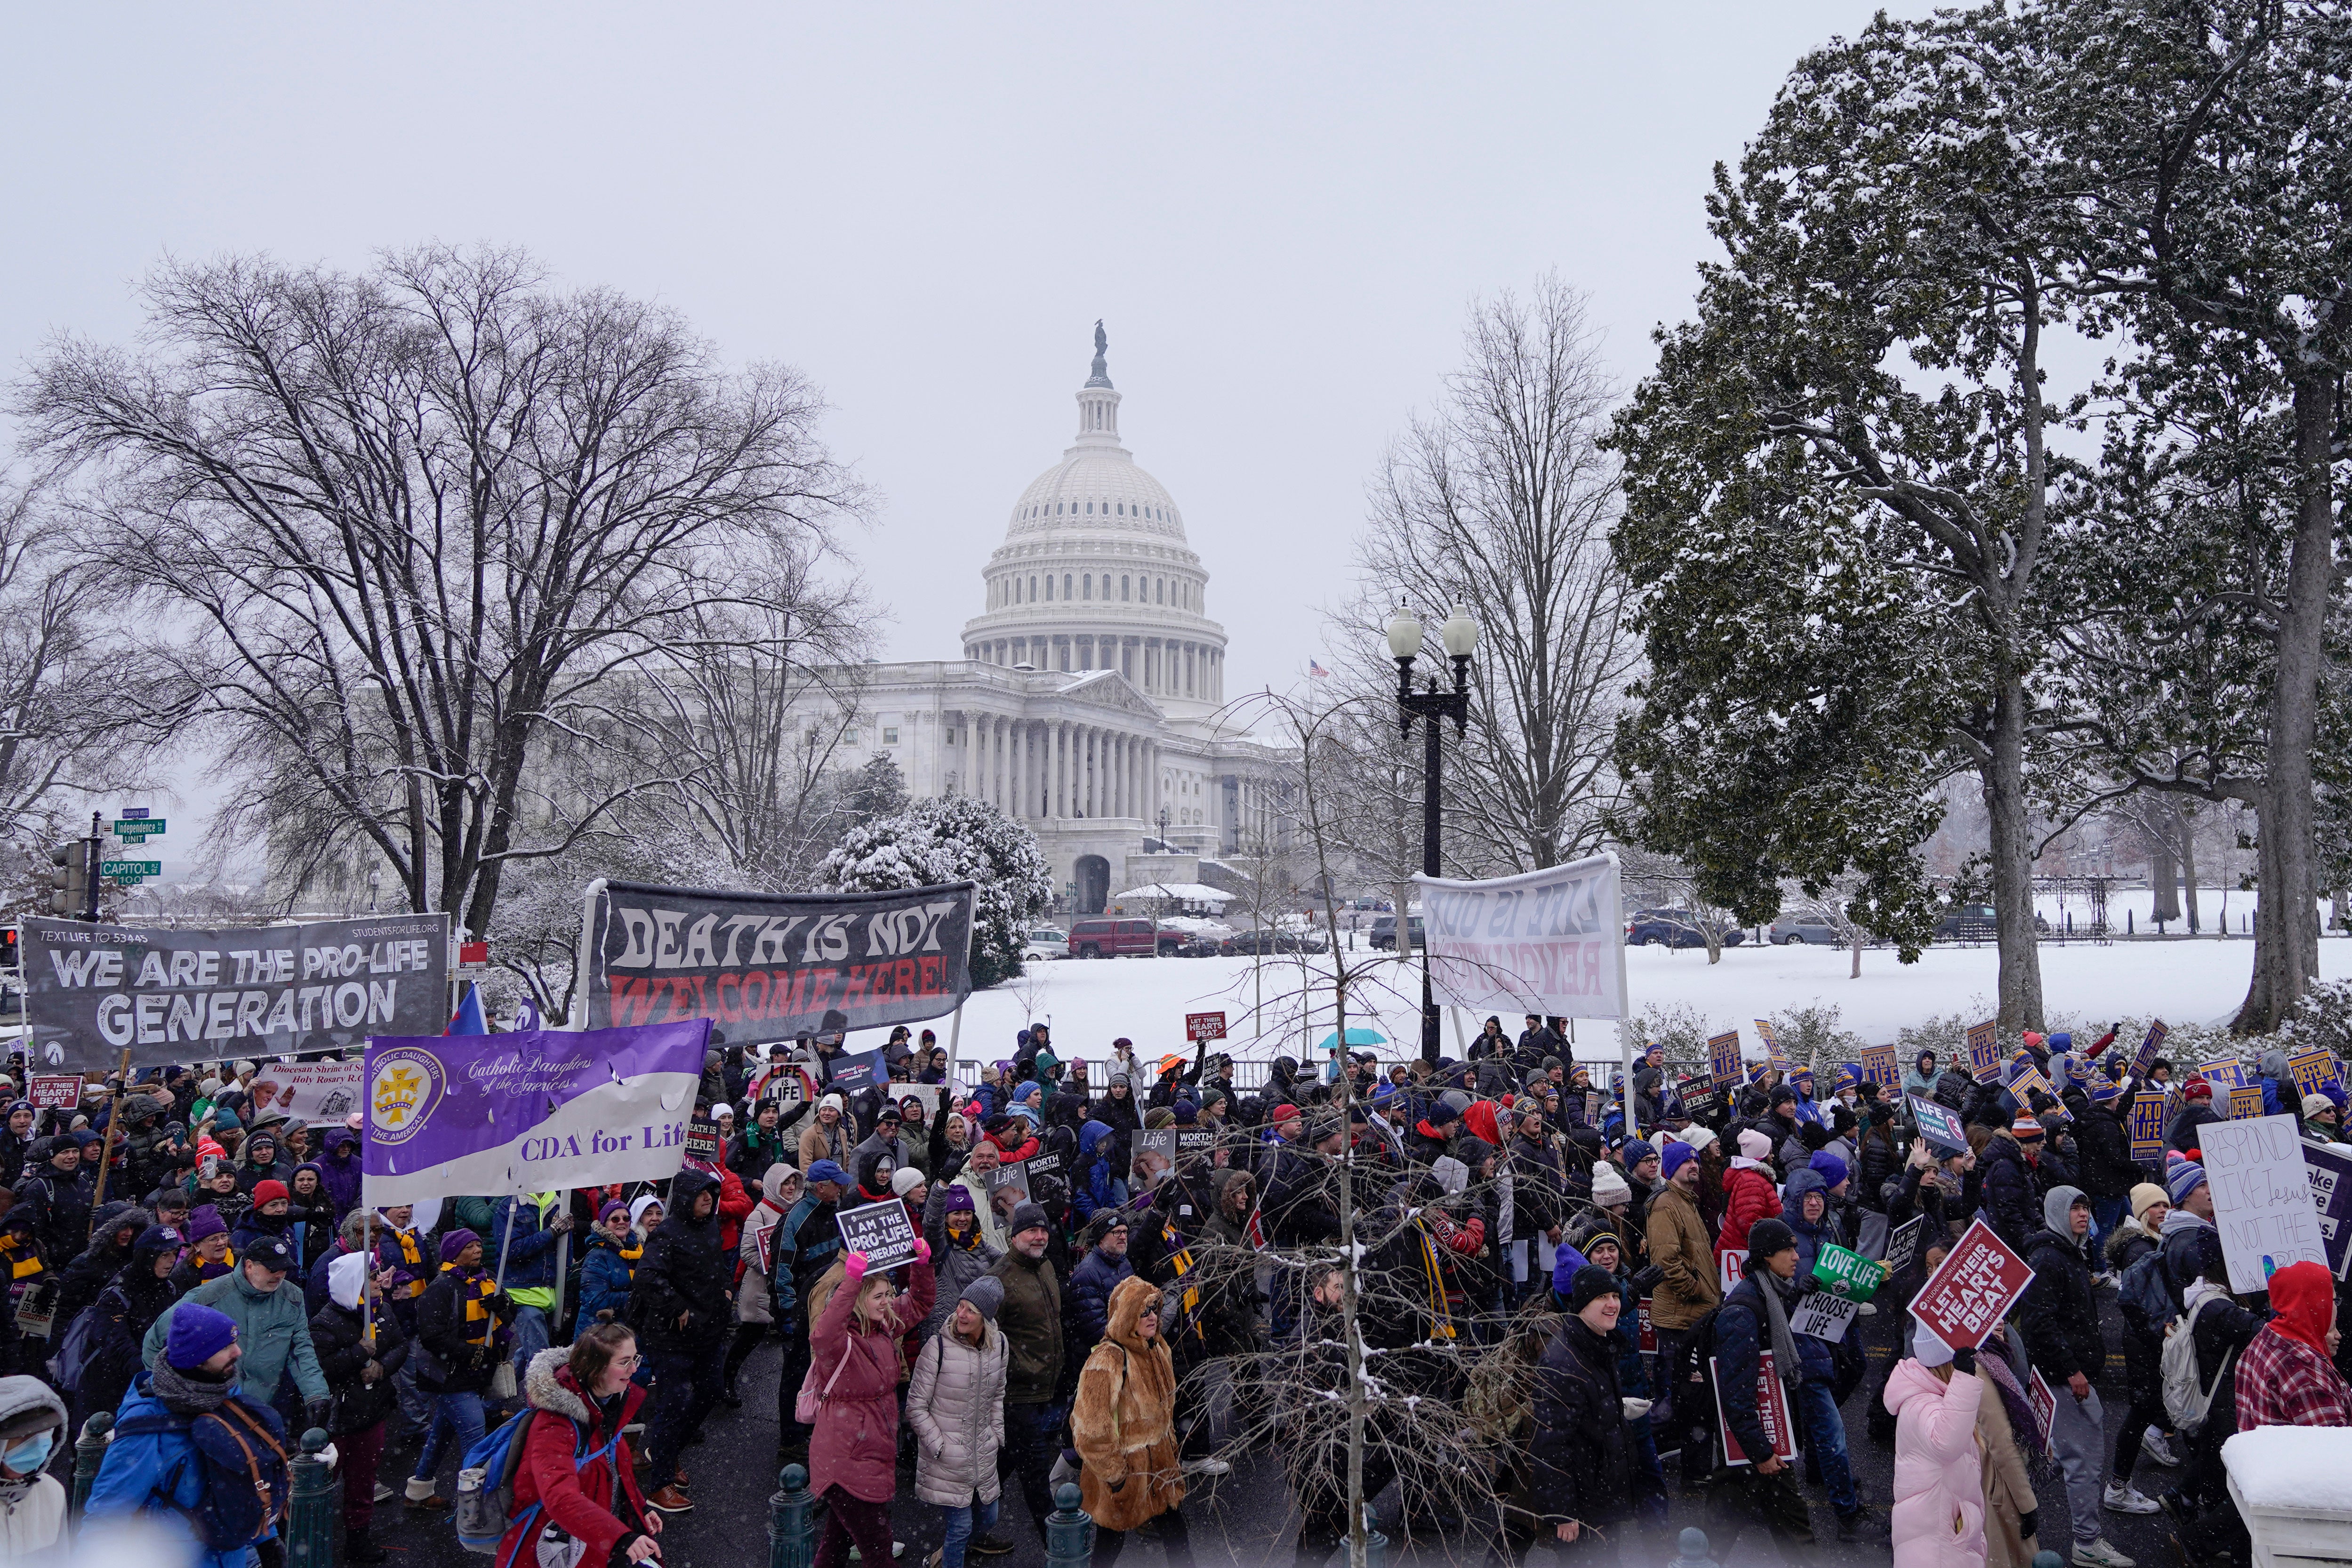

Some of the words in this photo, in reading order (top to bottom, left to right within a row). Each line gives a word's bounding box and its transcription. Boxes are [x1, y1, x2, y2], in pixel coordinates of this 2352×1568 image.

[118, 821, 156, 836] Independence
[125, 835, 143, 843] UNIT
[103, 863, 149, 875] CAPITOL
[40, 931, 66, 942] TEXT
[70, 932, 91, 942] LIFE
[94, 933, 110, 943] TO
[113, 933, 148, 943] 53445
[352, 924, 439, 938] STUDENTSFORLIFE.ORG
[610, 907, 808, 969] DEATH
[801, 913, 860, 963] IS
[866, 901, 957, 957] NOT
[49, 949, 123, 988] WE
[133, 951, 221, 987] ARE
[228, 949, 295, 984] THE
[303, 939, 428, 980] PRO-LIFE
[608, 967, 838, 1028] WELCOME
[837, 955, 949, 1010] HERE!
[97, 979, 397, 1046] GENERATION
[1189, 1022, 1223, 1031] HEARTS
[1196, 1029, 1218, 1037] BEAT
[1710, 1038, 1739, 1061] DEFEND
[1766, 1040, 1783, 1056] LIFE
[1968, 1028, 1996, 1052] DEFEND
[2146, 1029, 2164, 1050] PRO
[371, 1052, 400, 1080] ATHOLIC
[401, 1052, 440, 1080] DAUGHTERS
[457, 1054, 524, 1084] Catholic
[523, 1049, 594, 1079] Daughters
[1712, 1053, 1742, 1077] LIFE
[1862, 1052, 1896, 1070] DEFEND
[1970, 1043, 1999, 1070] LIFE
[2139, 1046, 2156, 1067] LIFE
[273, 1065, 312, 1073] Diocesan
[315, 1064, 342, 1073] Shrine
[344, 1064, 353, 1072] of
[770, 1064, 802, 1079] LIFE
[834, 1071, 853, 1080] unborn
[838, 1065, 857, 1075] Defend
[845, 1073, 863, 1082] moms!
[2220, 1067, 2236, 1080] AM
[2293, 1059, 2334, 1084] DEFEND
[292, 1076, 314, 1085] Holy
[316, 1076, 345, 1084] Rosary
[479, 1077, 498, 1098] of
[496, 1075, 512, 1091] the
[505, 1071, 571, 1099] Americas
[890, 1085, 911, 1096] EVERY
[914, 1086, 930, 1096] BABY
[1680, 1082, 1702, 1095] DEATH
[33, 1089, 75, 1097] HEARTS
[39, 1097, 67, 1105] BEAT
[769, 1086, 799, 1101] LIFE
[1684, 1094, 1714, 1109] HERE!
[1913, 1098, 1944, 1121] LIFE
[2137, 1102, 2161, 1121] PRO
[2232, 1095, 2262, 1117] DEFEND
[372, 1129, 389, 1140] THE
[390, 1114, 423, 1141] AMERICAS
[709, 1126, 717, 1134] IS
[1920, 1122, 1951, 1140] LIVING
[1926, 1115, 1945, 1128] WORTH
[2135, 1121, 2160, 1140] LIFE
[522, 1134, 583, 1161] CDA
[591, 1129, 633, 1154] for
[687, 1138, 715, 1152] HERE!
[1141, 1131, 1167, 1149] Life
[1180, 1133, 1213, 1141] WORTH
[2202, 1122, 2294, 1170] RESPOND
[1028, 1154, 1059, 1170] WORTH
[1029, 1162, 1060, 1175] PROTECTING
[995, 1166, 1018, 1185] Life
[2308, 1168, 2333, 1190] ake
[2210, 1168, 2263, 1213] LIKE
[2262, 1168, 2310, 1207] Jesus
[848, 1225, 854, 1236] I
[859, 1219, 877, 1233] AM
[879, 1213, 903, 1227] THE
[2229, 1217, 2264, 1251] NOT
[2270, 1212, 2312, 1245] THE
[849, 1223, 912, 1252] PRO-LIFE
[1895, 1233, 1905, 1246] AM
[1906, 1227, 1918, 1239] THE
[866, 1239, 915, 1263] ENERATION
[1888, 1236, 1916, 1260] PRO-LIFE
[1820, 1246, 1856, 1278] LOVE
[1852, 1261, 1882, 1289] LIFE
[1925, 1229, 1983, 1303] STUDENTSFORLIFEACTION.ORG
[1930, 1285, 1954, 1317] LET
[1951, 1243, 1990, 1286] THEIR
[1938, 1249, 2005, 1334] HEARTS
[1804, 1293, 1854, 1320] CHOOSE
[1962, 1274, 2008, 1334] BEAT
[1980, 1319, 1989, 1332] TEXT
[1988, 1311, 1996, 1322] LIFE
[1999, 1293, 2011, 1307] 53445
[1804, 1313, 1831, 1336] LIFE
[1768, 1368, 1786, 1452] STUDENTSFORLIFEACTION.ORG
[2031, 1384, 2039, 1402] LET
[2037, 1395, 2049, 1421] THEIR
[2028, 1395, 2048, 1439] HEARTS
